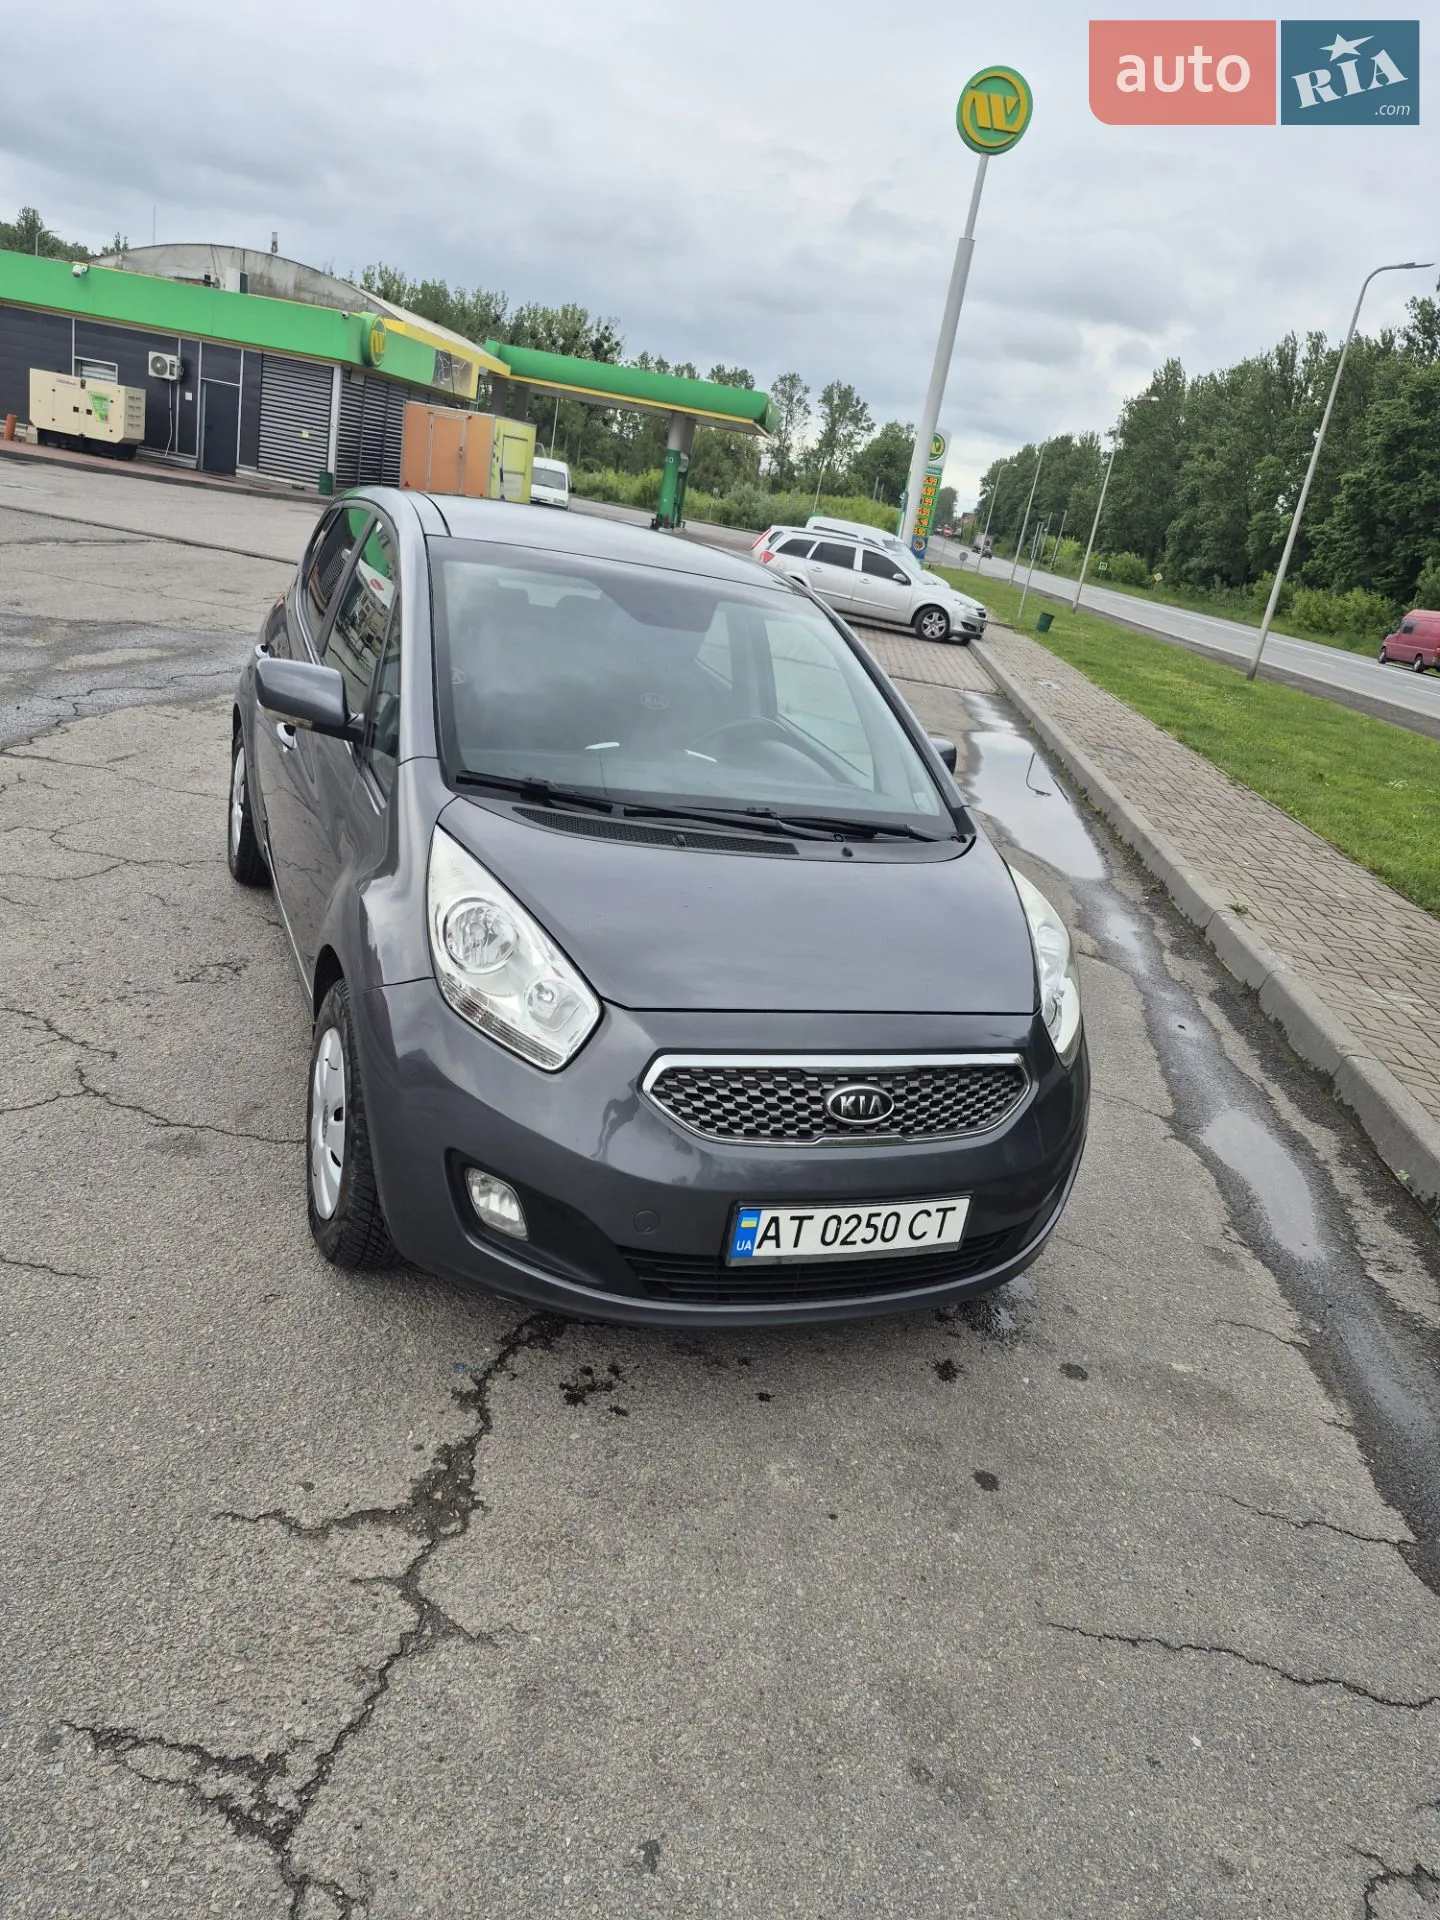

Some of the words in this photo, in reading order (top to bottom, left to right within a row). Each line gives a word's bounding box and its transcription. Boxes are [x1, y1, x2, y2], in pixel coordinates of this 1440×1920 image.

[645, 695, 665, 706] KIA
[839, 1094, 884, 1117] KIA
[756, 1214, 815, 1250] AT
[820, 1211, 901, 1246] 0250
[907, 1206, 957, 1241] CT
[736, 1240, 752, 1252] UA
